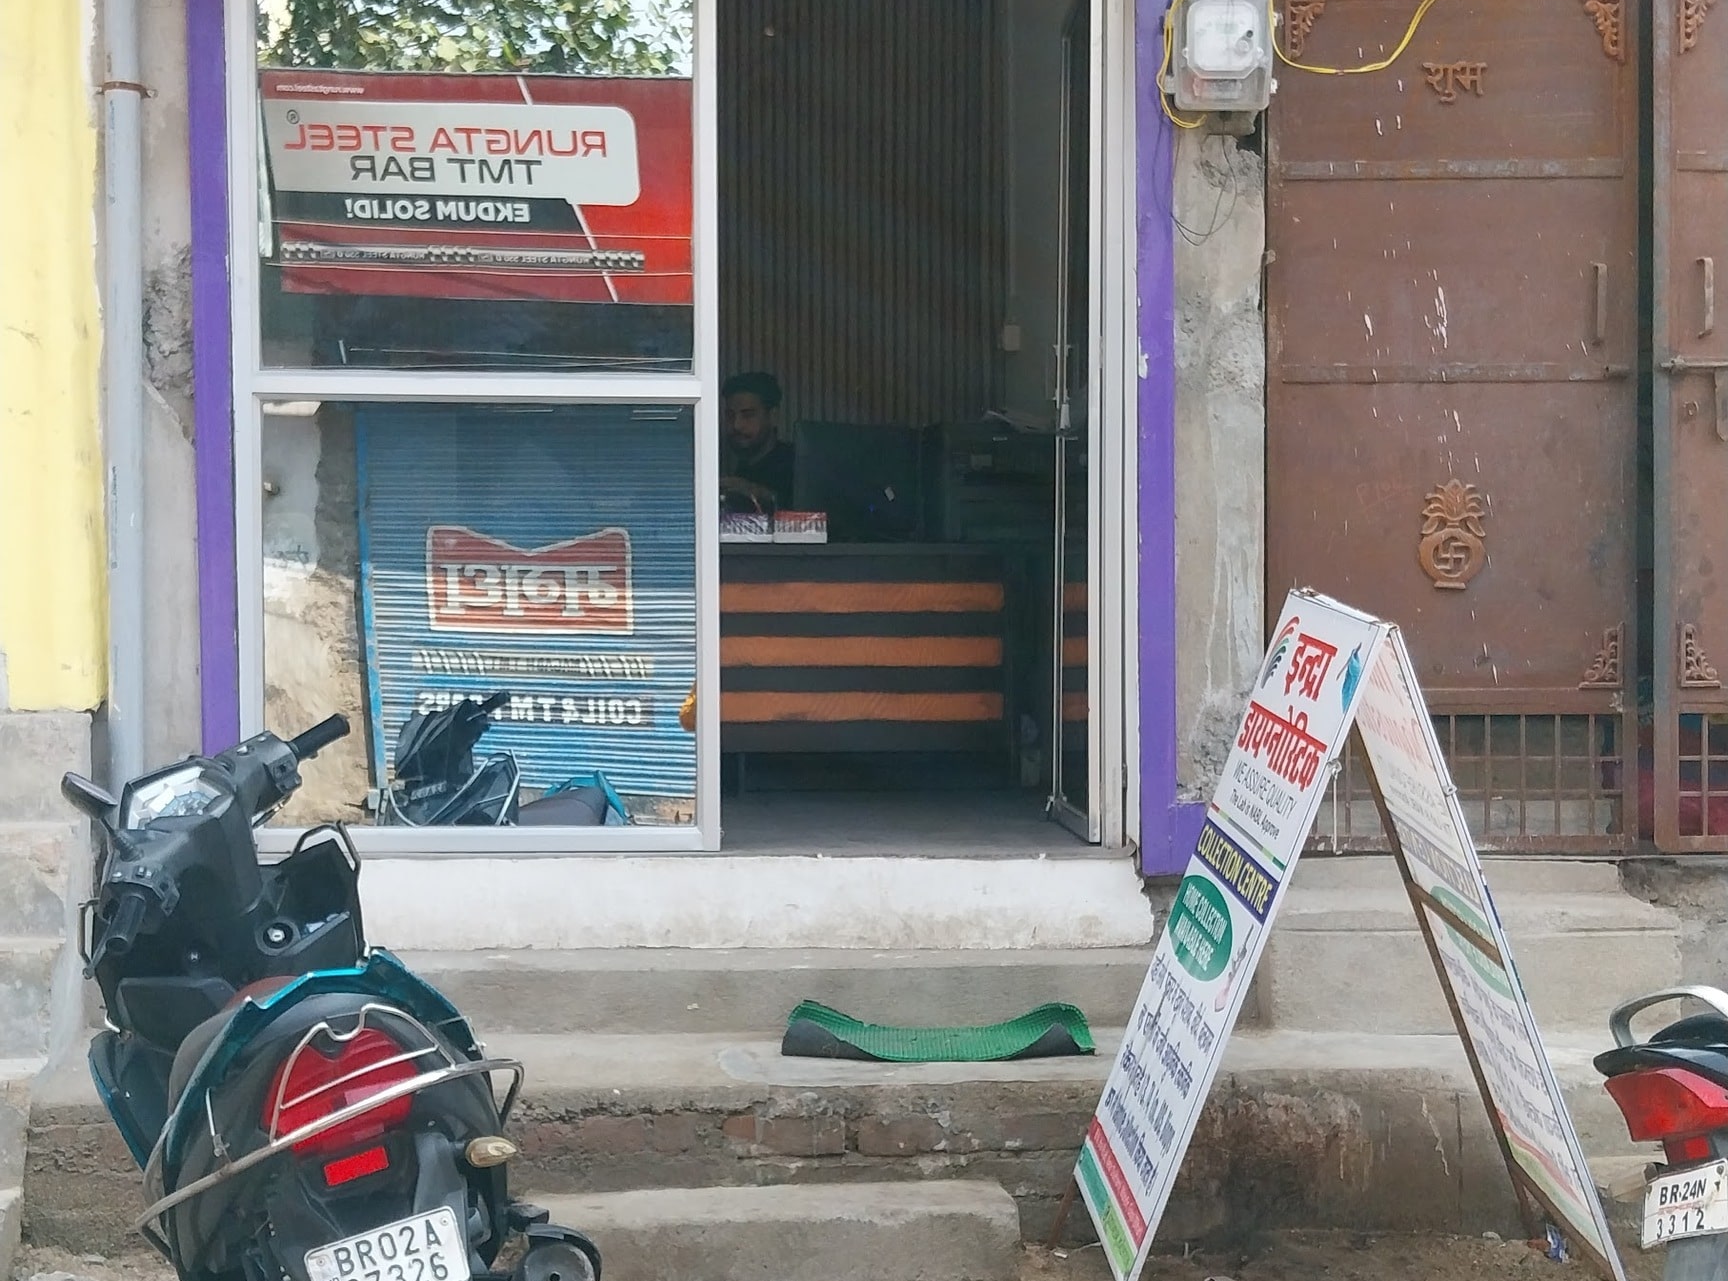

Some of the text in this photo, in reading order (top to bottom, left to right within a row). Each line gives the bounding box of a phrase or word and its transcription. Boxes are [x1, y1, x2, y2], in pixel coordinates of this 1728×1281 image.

[1422, 61, 1488, 102] शुभ
[1233, 760, 1248, 783] WE
[1265, 780, 1297, 819] QUALITY
[1197, 825, 1273, 915] COLLECTION CENTRE
[334, 1219, 442, 1277] BR02A
[1656, 1209, 1704, 1239] 3312
